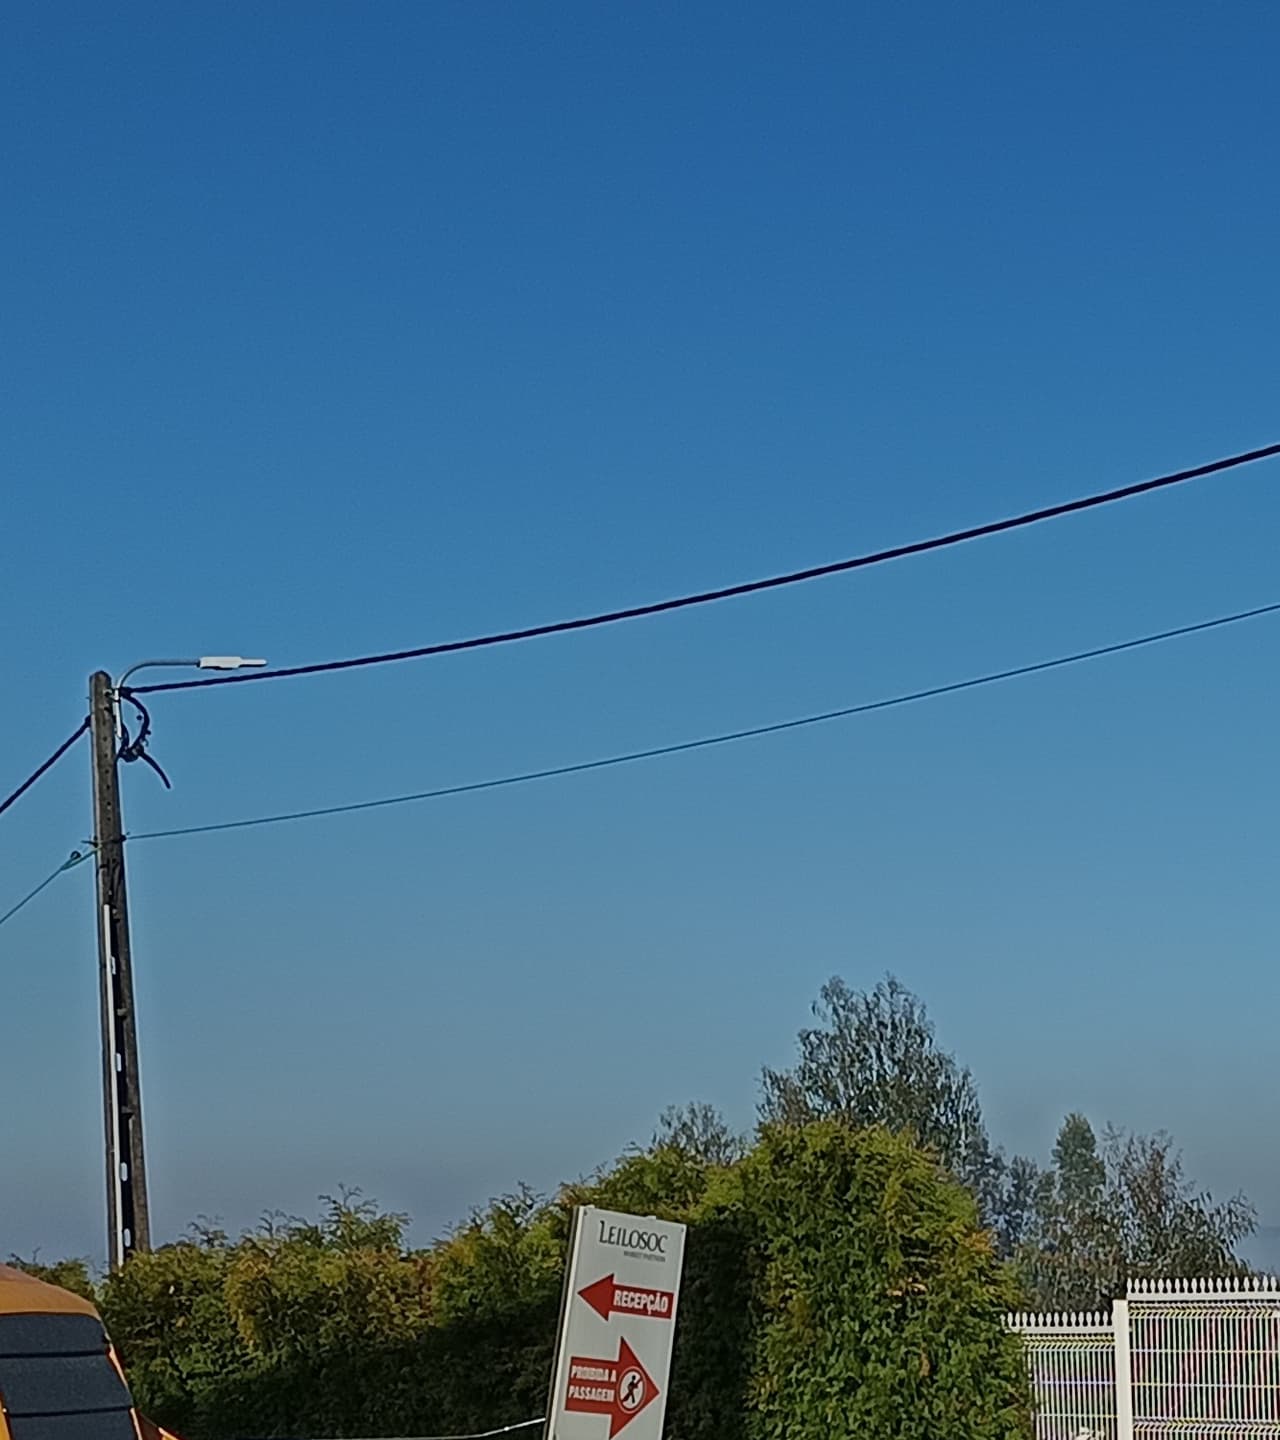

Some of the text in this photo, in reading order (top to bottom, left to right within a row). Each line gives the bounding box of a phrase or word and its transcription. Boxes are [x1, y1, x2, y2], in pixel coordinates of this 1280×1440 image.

[599, 1220, 669, 1253] LEILOSOC
[613, 1289, 669, 1315] RECEPÇÃO
[568, 1385, 615, 1402] PASSAGEM
